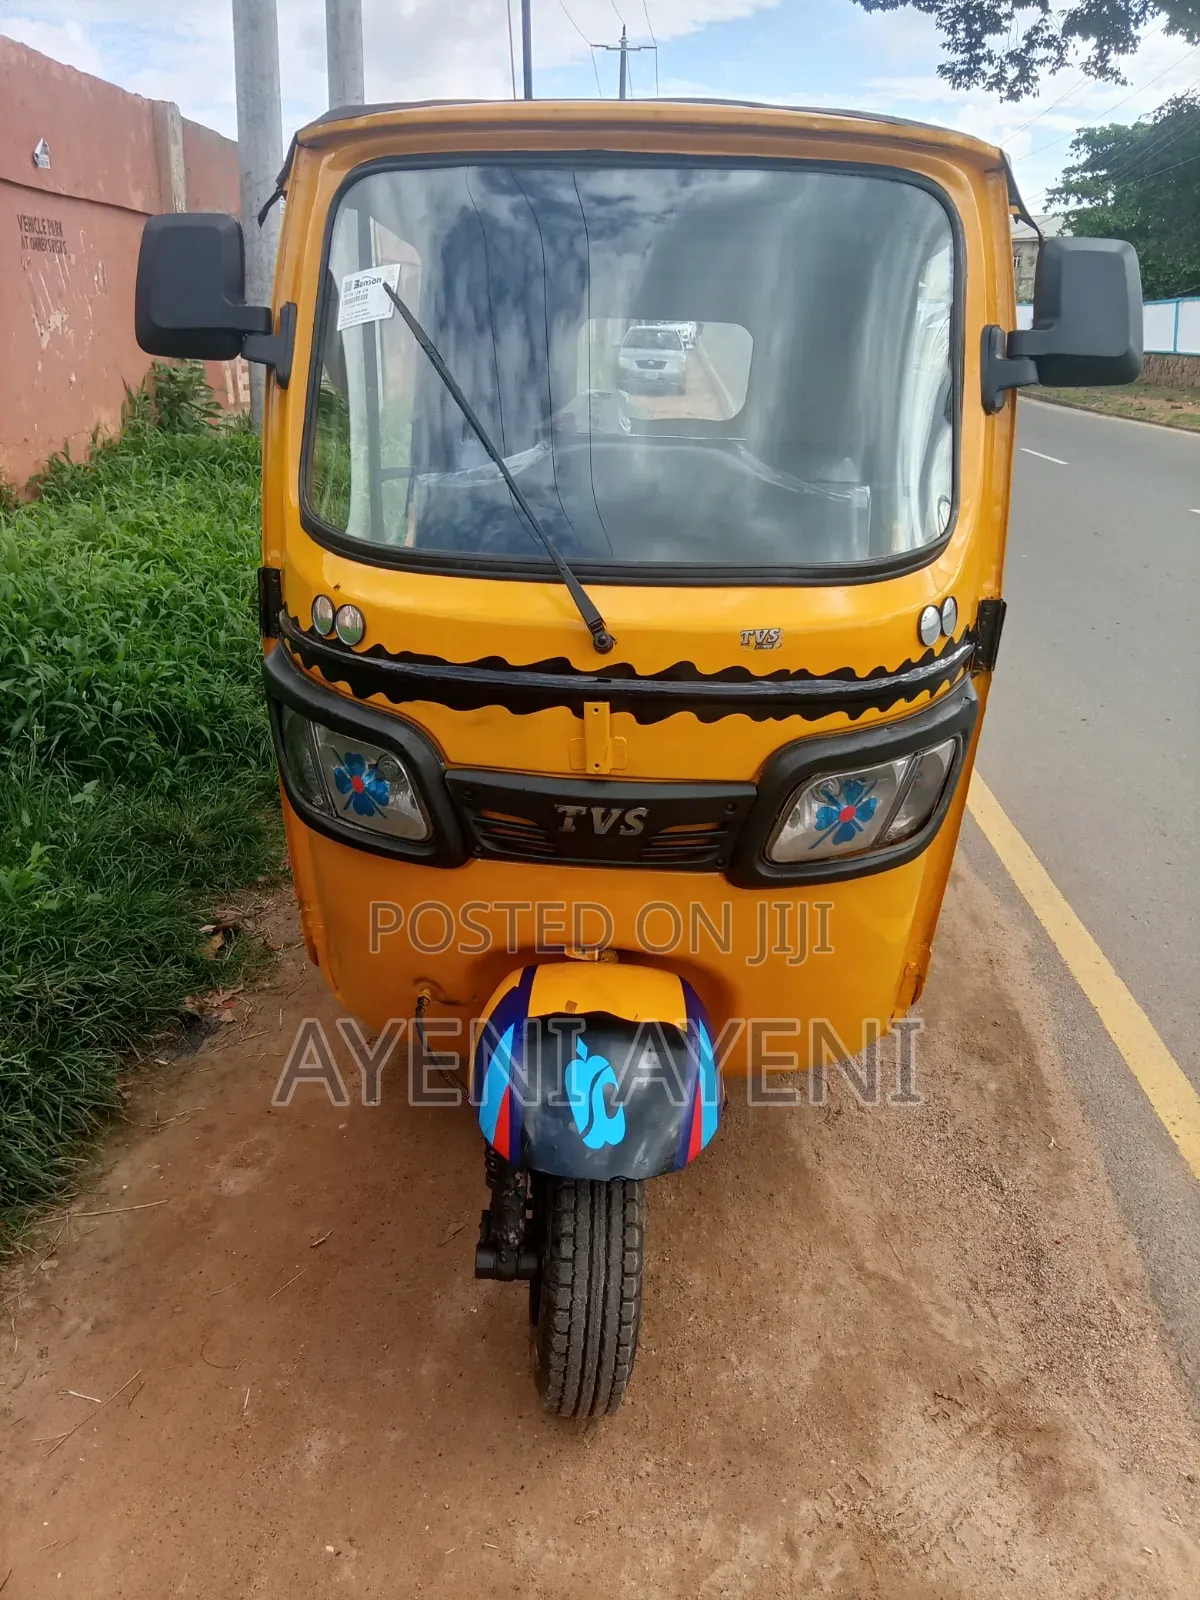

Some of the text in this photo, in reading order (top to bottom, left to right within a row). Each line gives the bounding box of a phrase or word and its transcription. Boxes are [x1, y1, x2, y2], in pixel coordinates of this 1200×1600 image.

[16, 214, 63, 237] VEHICLE PARK
[21, 235, 29, 250] AT
[740, 628, 780, 645] TVS
[554, 804, 649, 836] TVS
